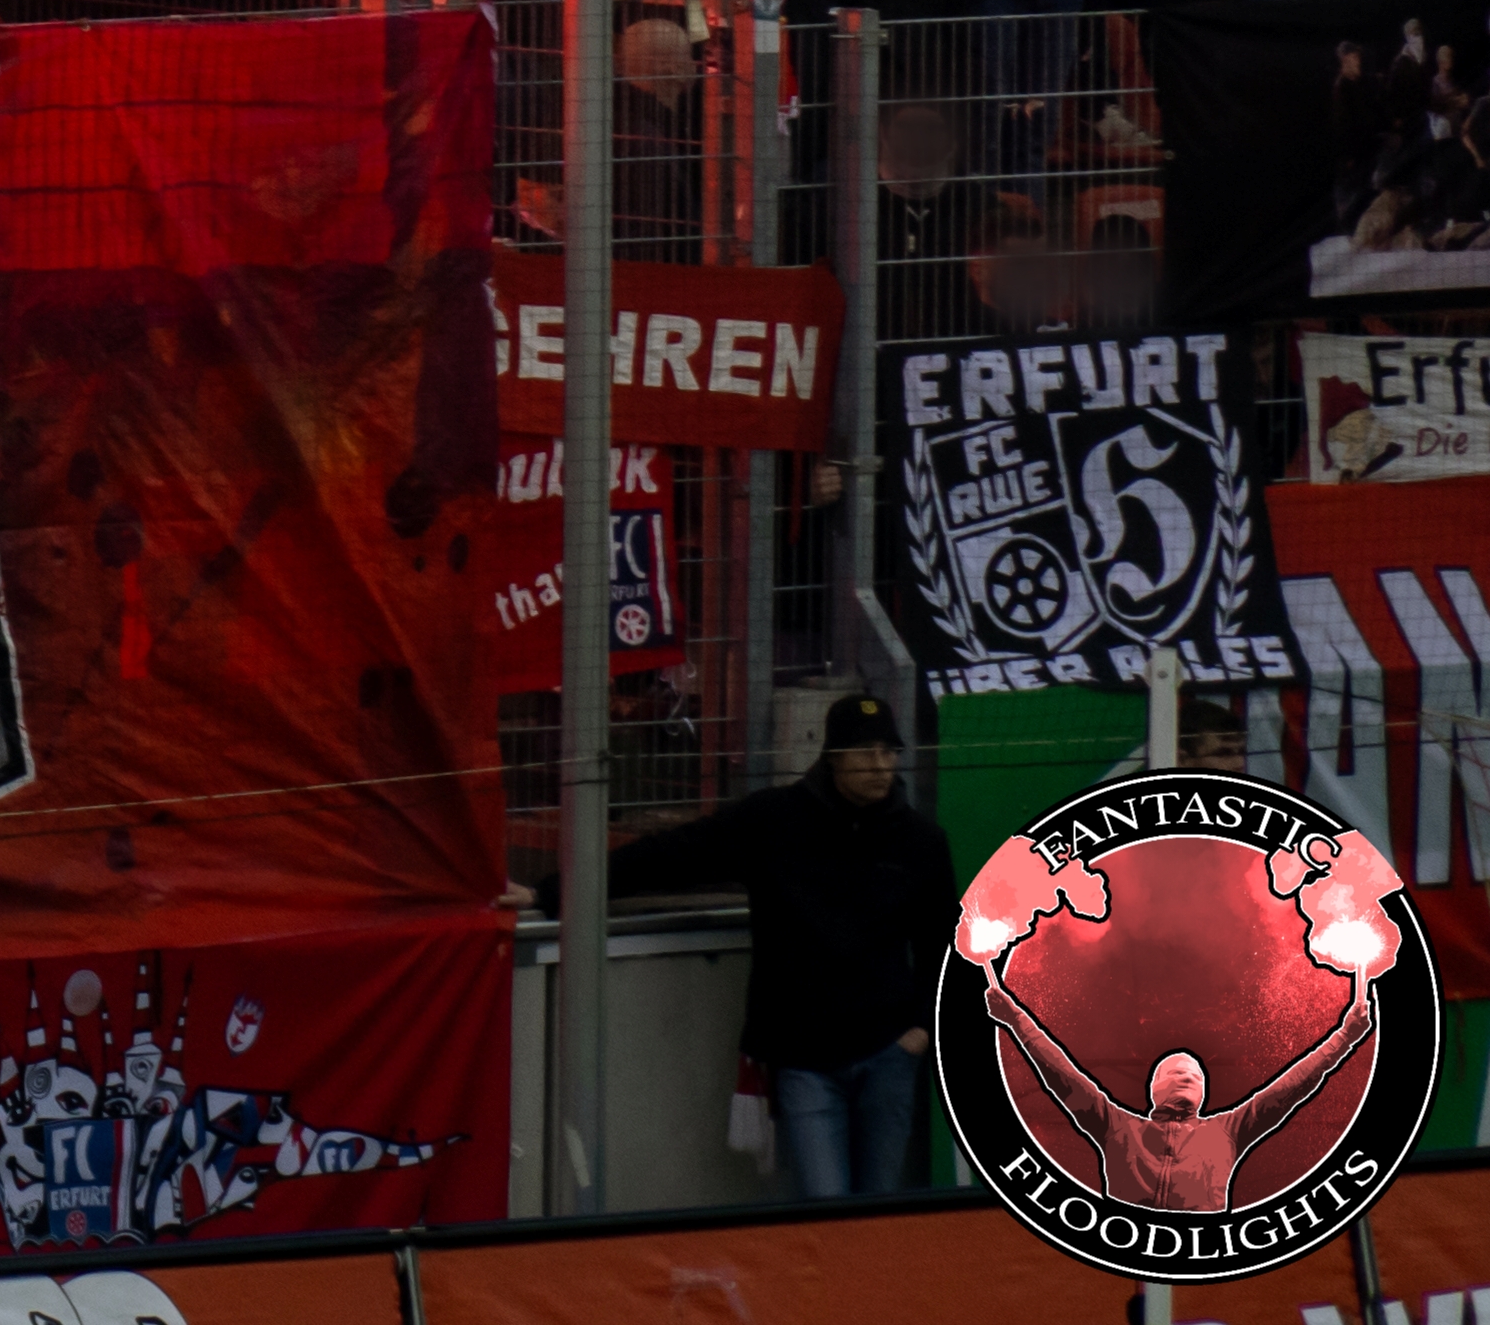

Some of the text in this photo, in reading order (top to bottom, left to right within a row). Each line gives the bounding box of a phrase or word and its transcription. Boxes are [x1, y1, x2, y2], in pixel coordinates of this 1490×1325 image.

[902, 334, 1227, 426] ERFURT
[1366, 339, 1490, 416] Erf
[962, 425, 1024, 477] FC
[1414, 425, 1470, 458] Die
[947, 459, 1053, 525] RWE
[1108, 635, 1295, 682] ALES
[50, 1185, 112, 1211] ERFURT
